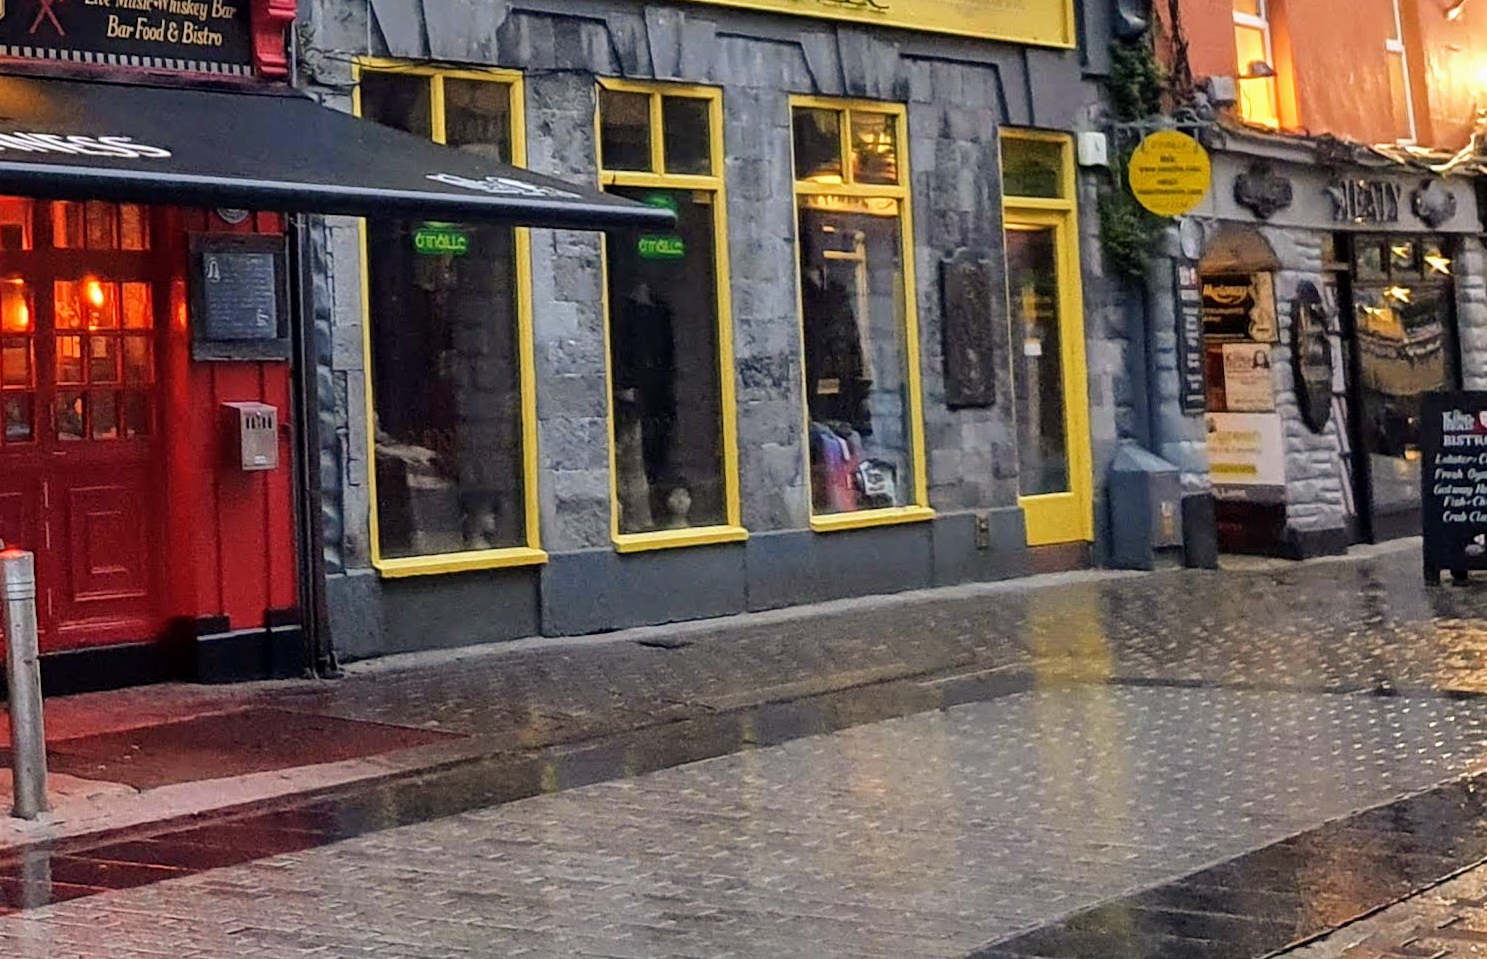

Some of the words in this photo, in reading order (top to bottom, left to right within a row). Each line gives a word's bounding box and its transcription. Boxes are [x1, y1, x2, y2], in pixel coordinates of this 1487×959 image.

[107, 14, 134, 39] Bar
[135, 17, 165, 42] Food
[167, 22, 179, 43] &
[182, 21, 223, 47] Bistro
[1443, 434, 1487, 447] BISTR
